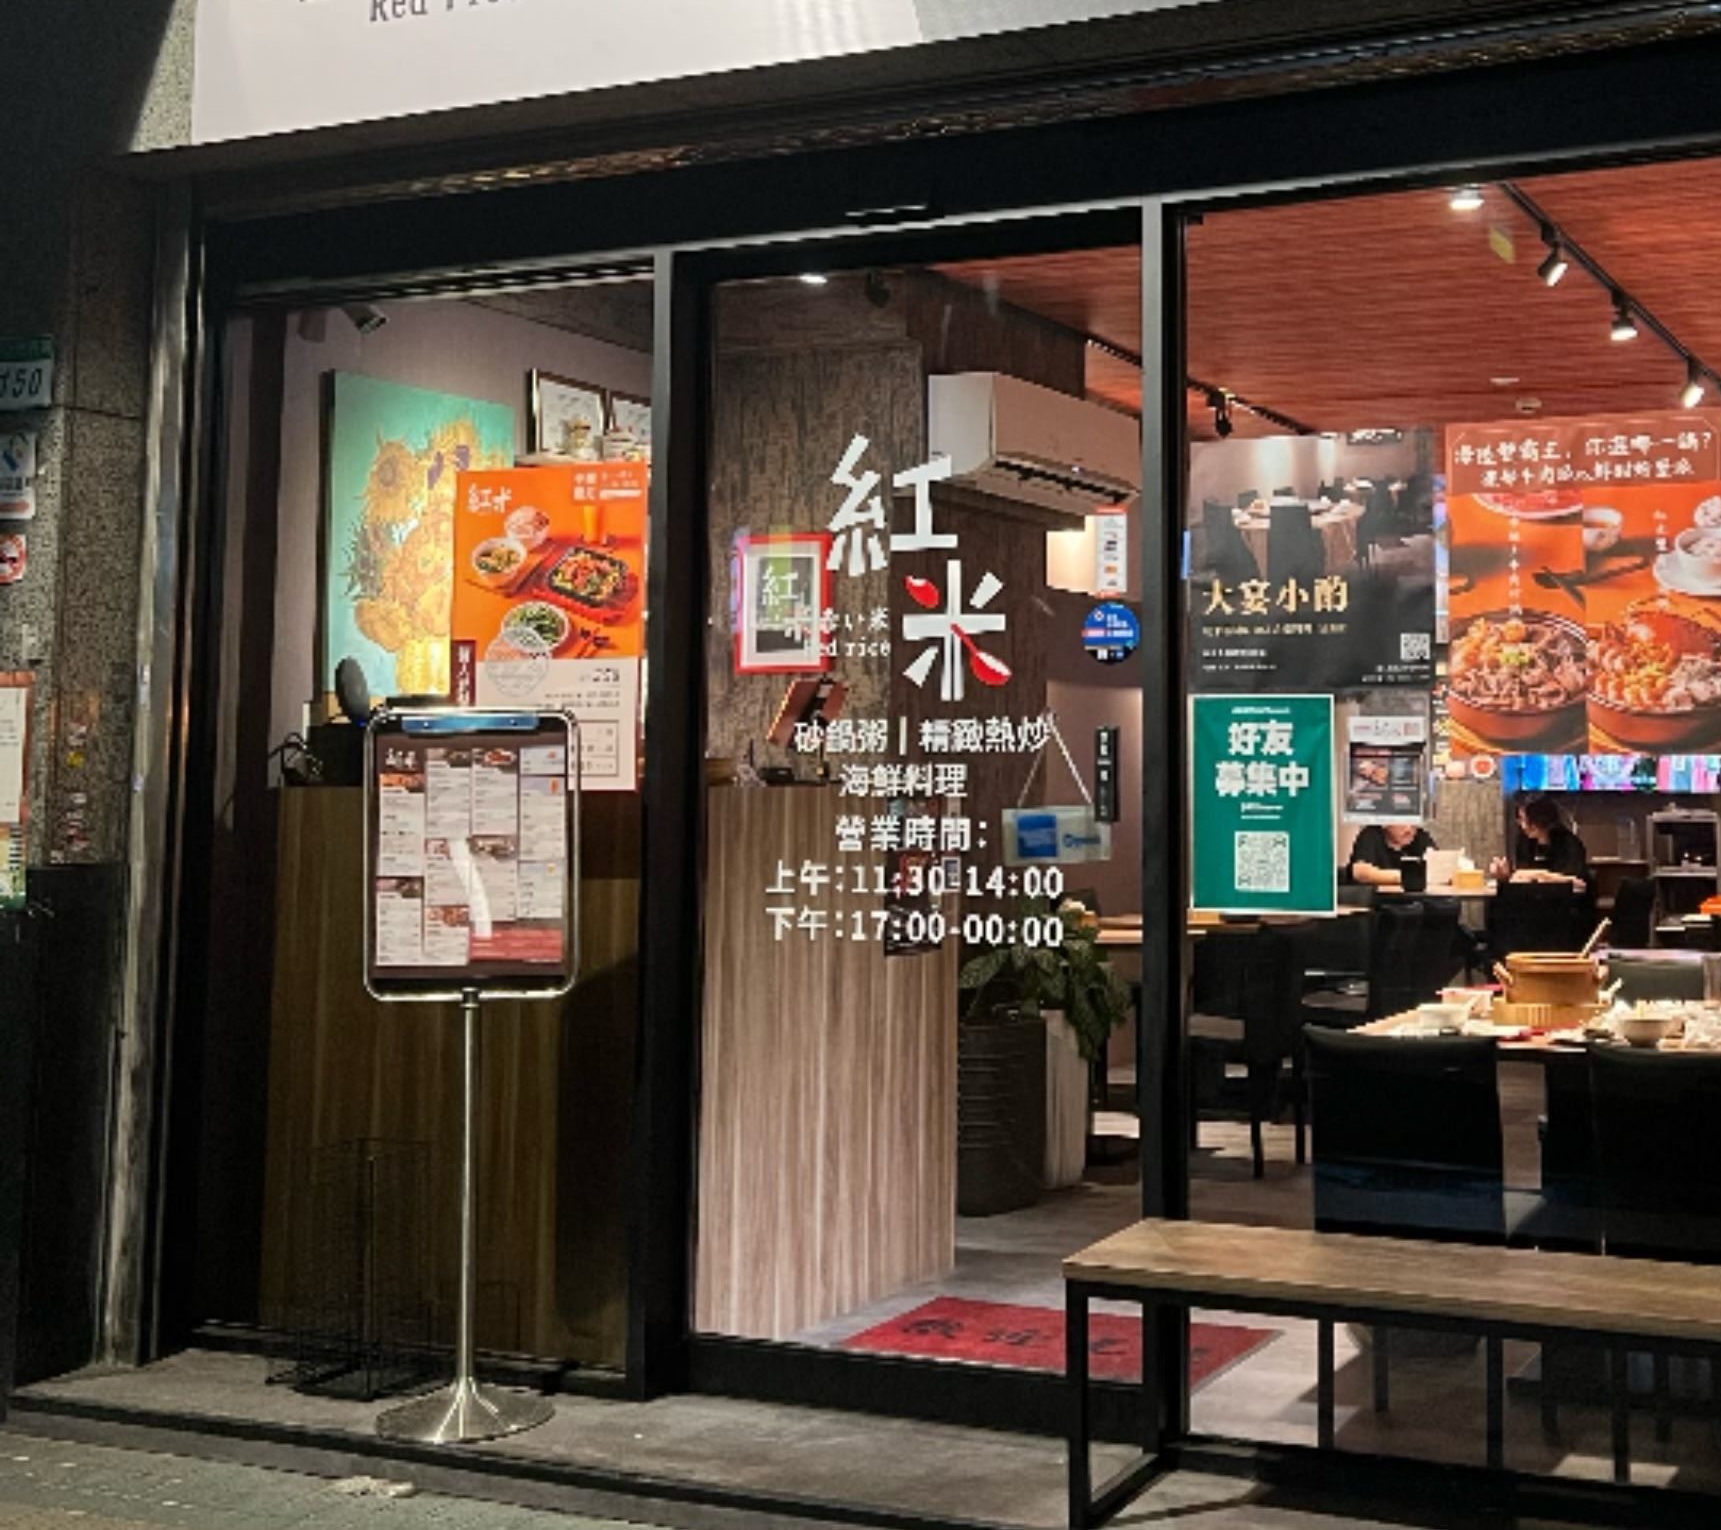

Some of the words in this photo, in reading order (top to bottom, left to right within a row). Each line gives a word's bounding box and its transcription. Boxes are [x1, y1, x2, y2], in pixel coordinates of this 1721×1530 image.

[1203, 576, 1348, 615] 大宴小酌
[845, 636, 891, 657] rice
[794, 718, 888, 754] 砂鍋粥
[1228, 719, 1294, 756] 好友
[838, 763, 968, 798] 海鮮料理
[1215, 761, 1309, 797] 募集中
